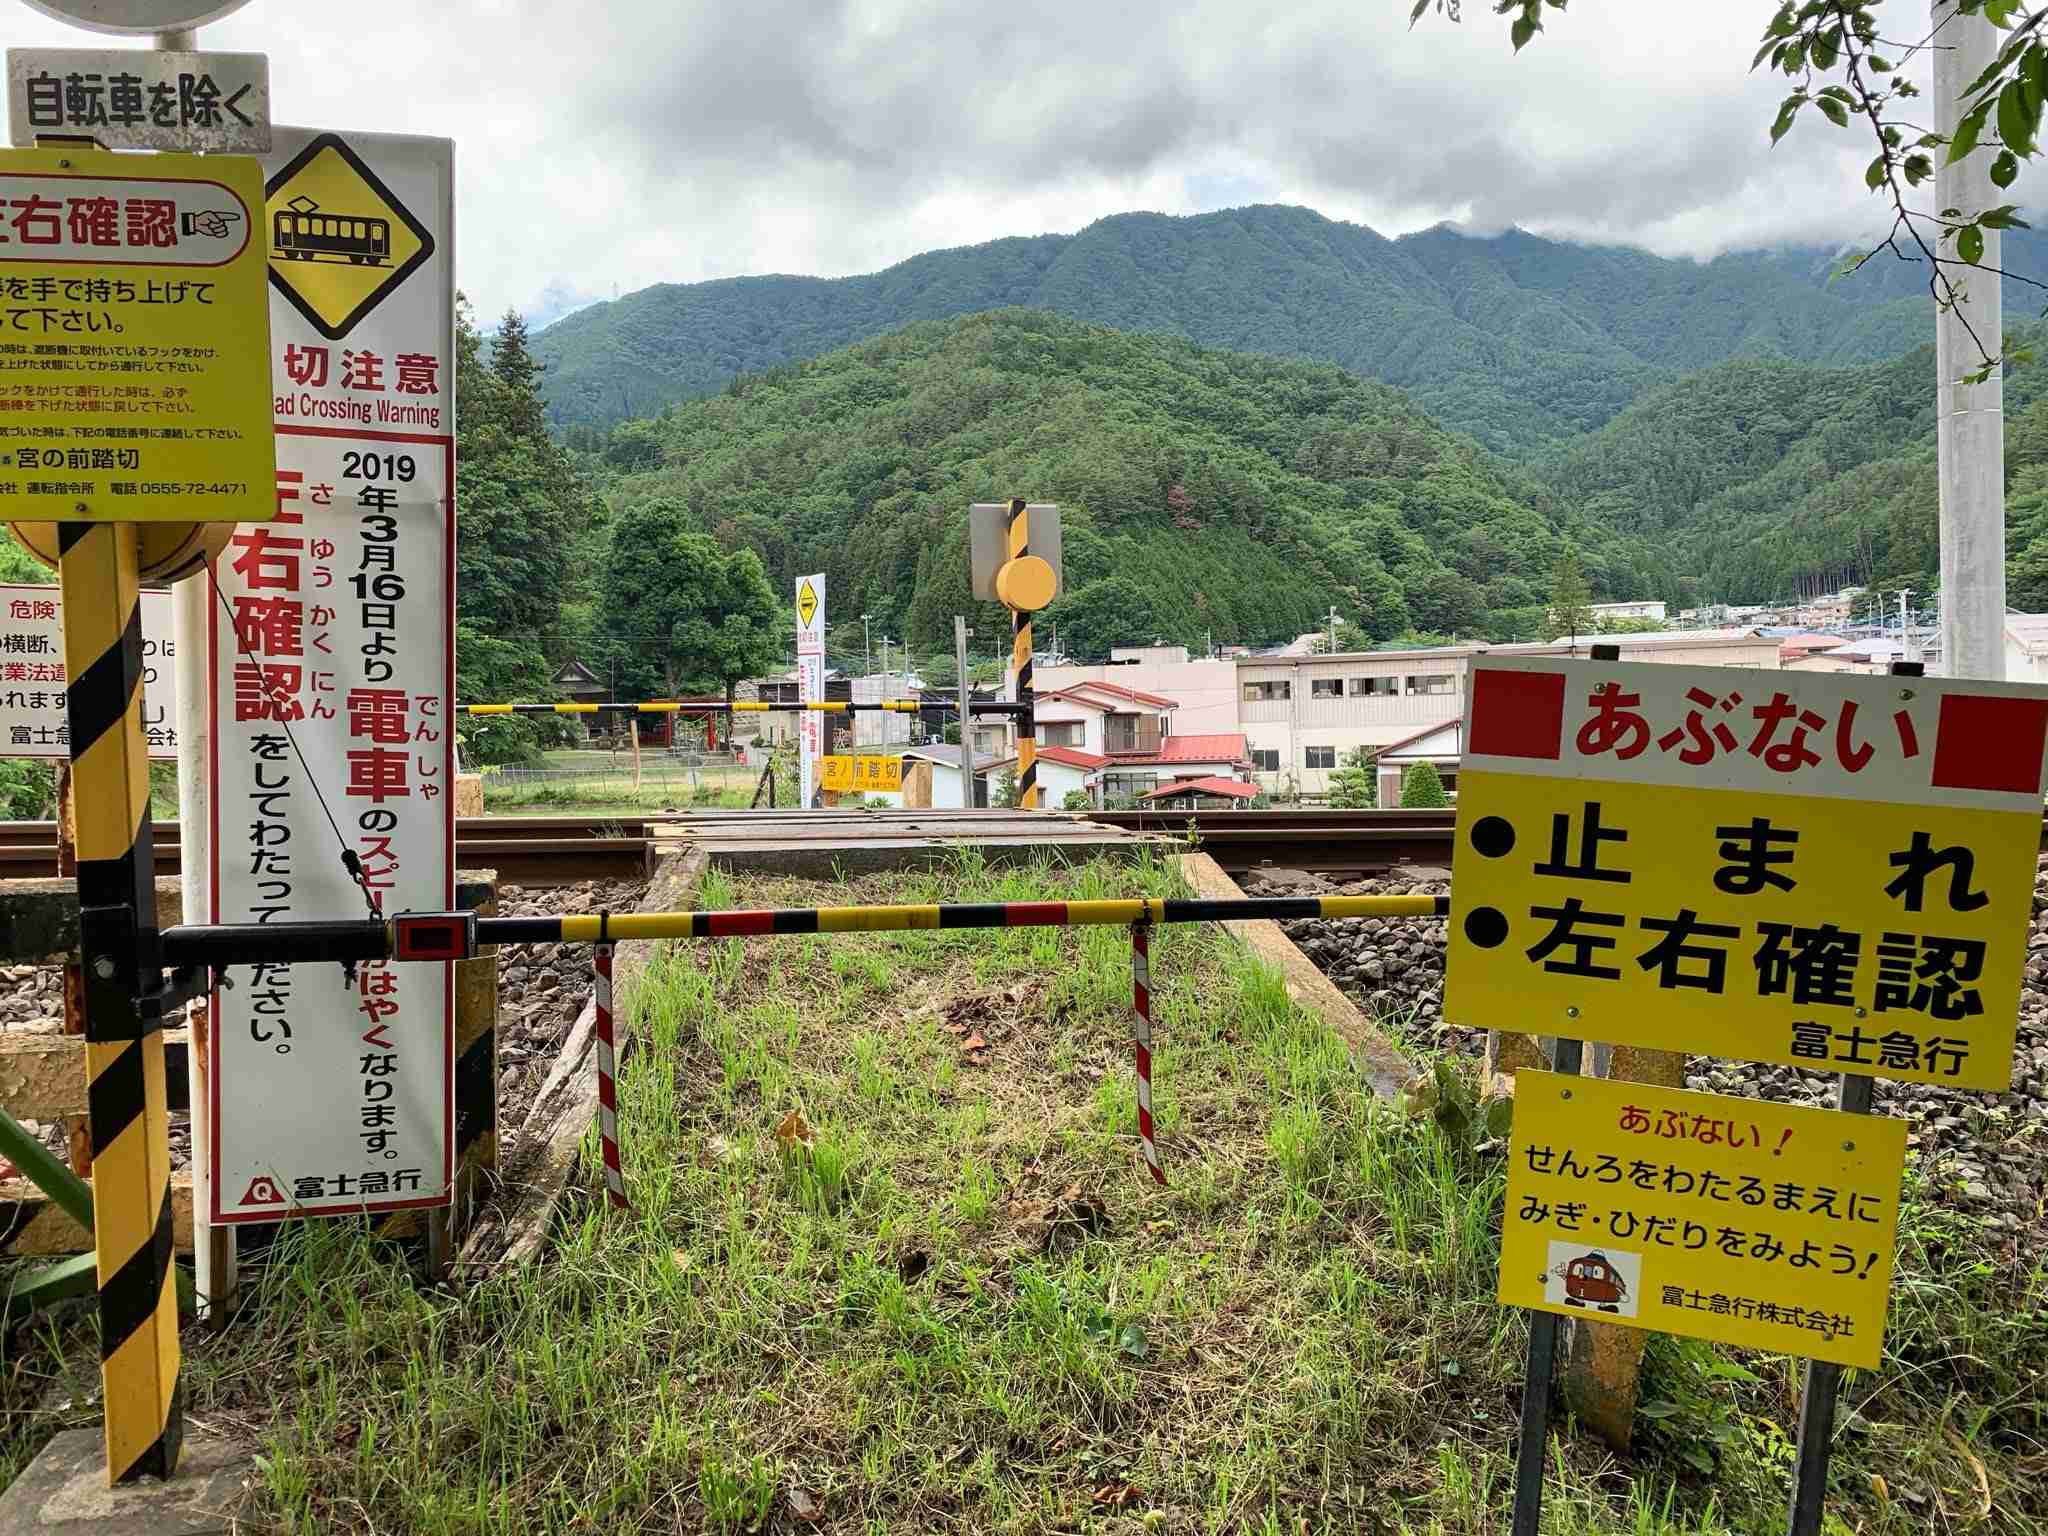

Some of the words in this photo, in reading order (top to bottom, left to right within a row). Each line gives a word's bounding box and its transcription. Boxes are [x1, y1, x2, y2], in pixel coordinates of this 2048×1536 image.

[27, 71, 254, 127] 自転車を除く
[0, 194, 178, 248] 右確認
[0, 277, 215, 304] を手で持ち上げて
[0, 308, 125, 334] て下さい。
[300, 393, 372, 424] Crossing
[377, 399, 440, 429] Warning
[17, 448, 139, 470] 宮の前踏切
[10, 599, 62, 620] 危険
[0, 633, 57, 654] 横断、
[0, 690, 66, 709] れます
[1575, 682, 1920, 774] あぶない
[1525, 897, 1988, 1022] 左右確認
[1791, 1020, 1969, 1077] 富士急行
[293, 1168, 422, 1199] 富士急行
[1524, 1144, 1882, 1224] せんろをわたるまえに
[1661, 1284, 1855, 1338] 富士急行株式会社
